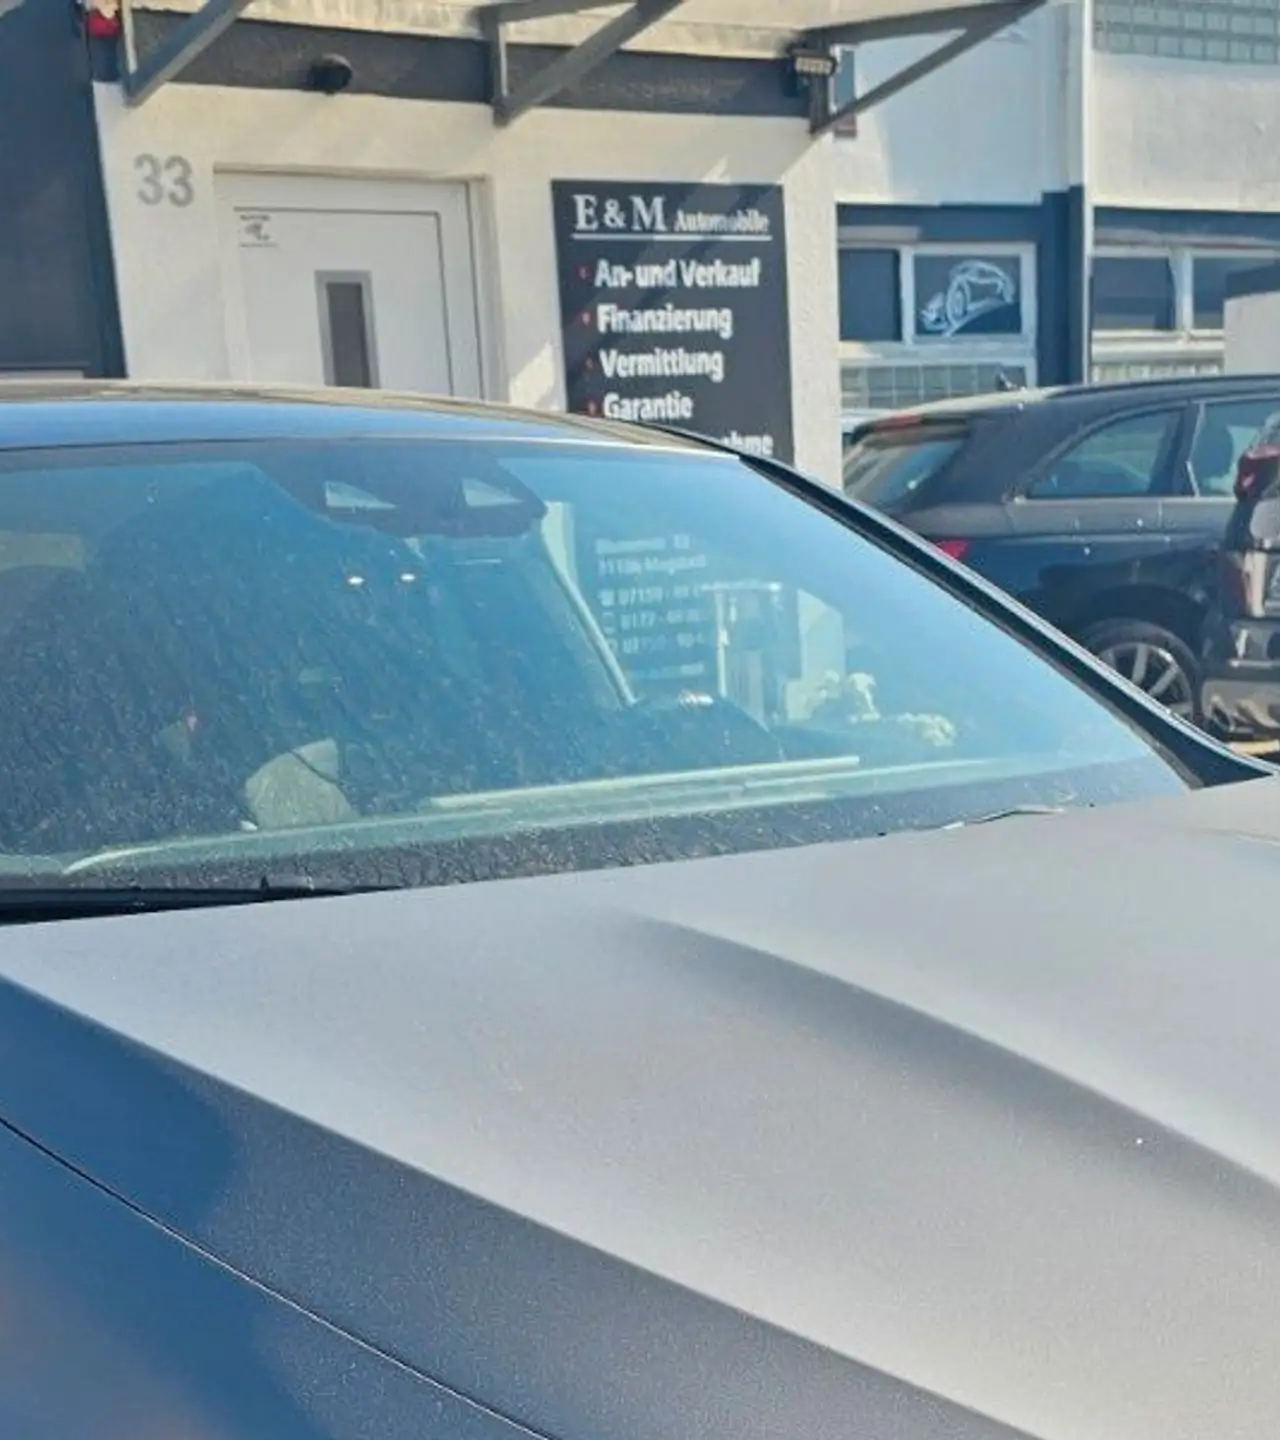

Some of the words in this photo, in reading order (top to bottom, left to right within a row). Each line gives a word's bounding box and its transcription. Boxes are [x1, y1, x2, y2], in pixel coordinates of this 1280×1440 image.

[133, 152, 195, 208] 33
[674, 208, 770, 233] Automobile
[635, 258, 676, 288] und
[678, 256, 762, 288] Verkauf
[596, 303, 733, 340] Finanzierung
[599, 347, 724, 383] Vermittlung
[602, 390, 694, 420] Garantie
